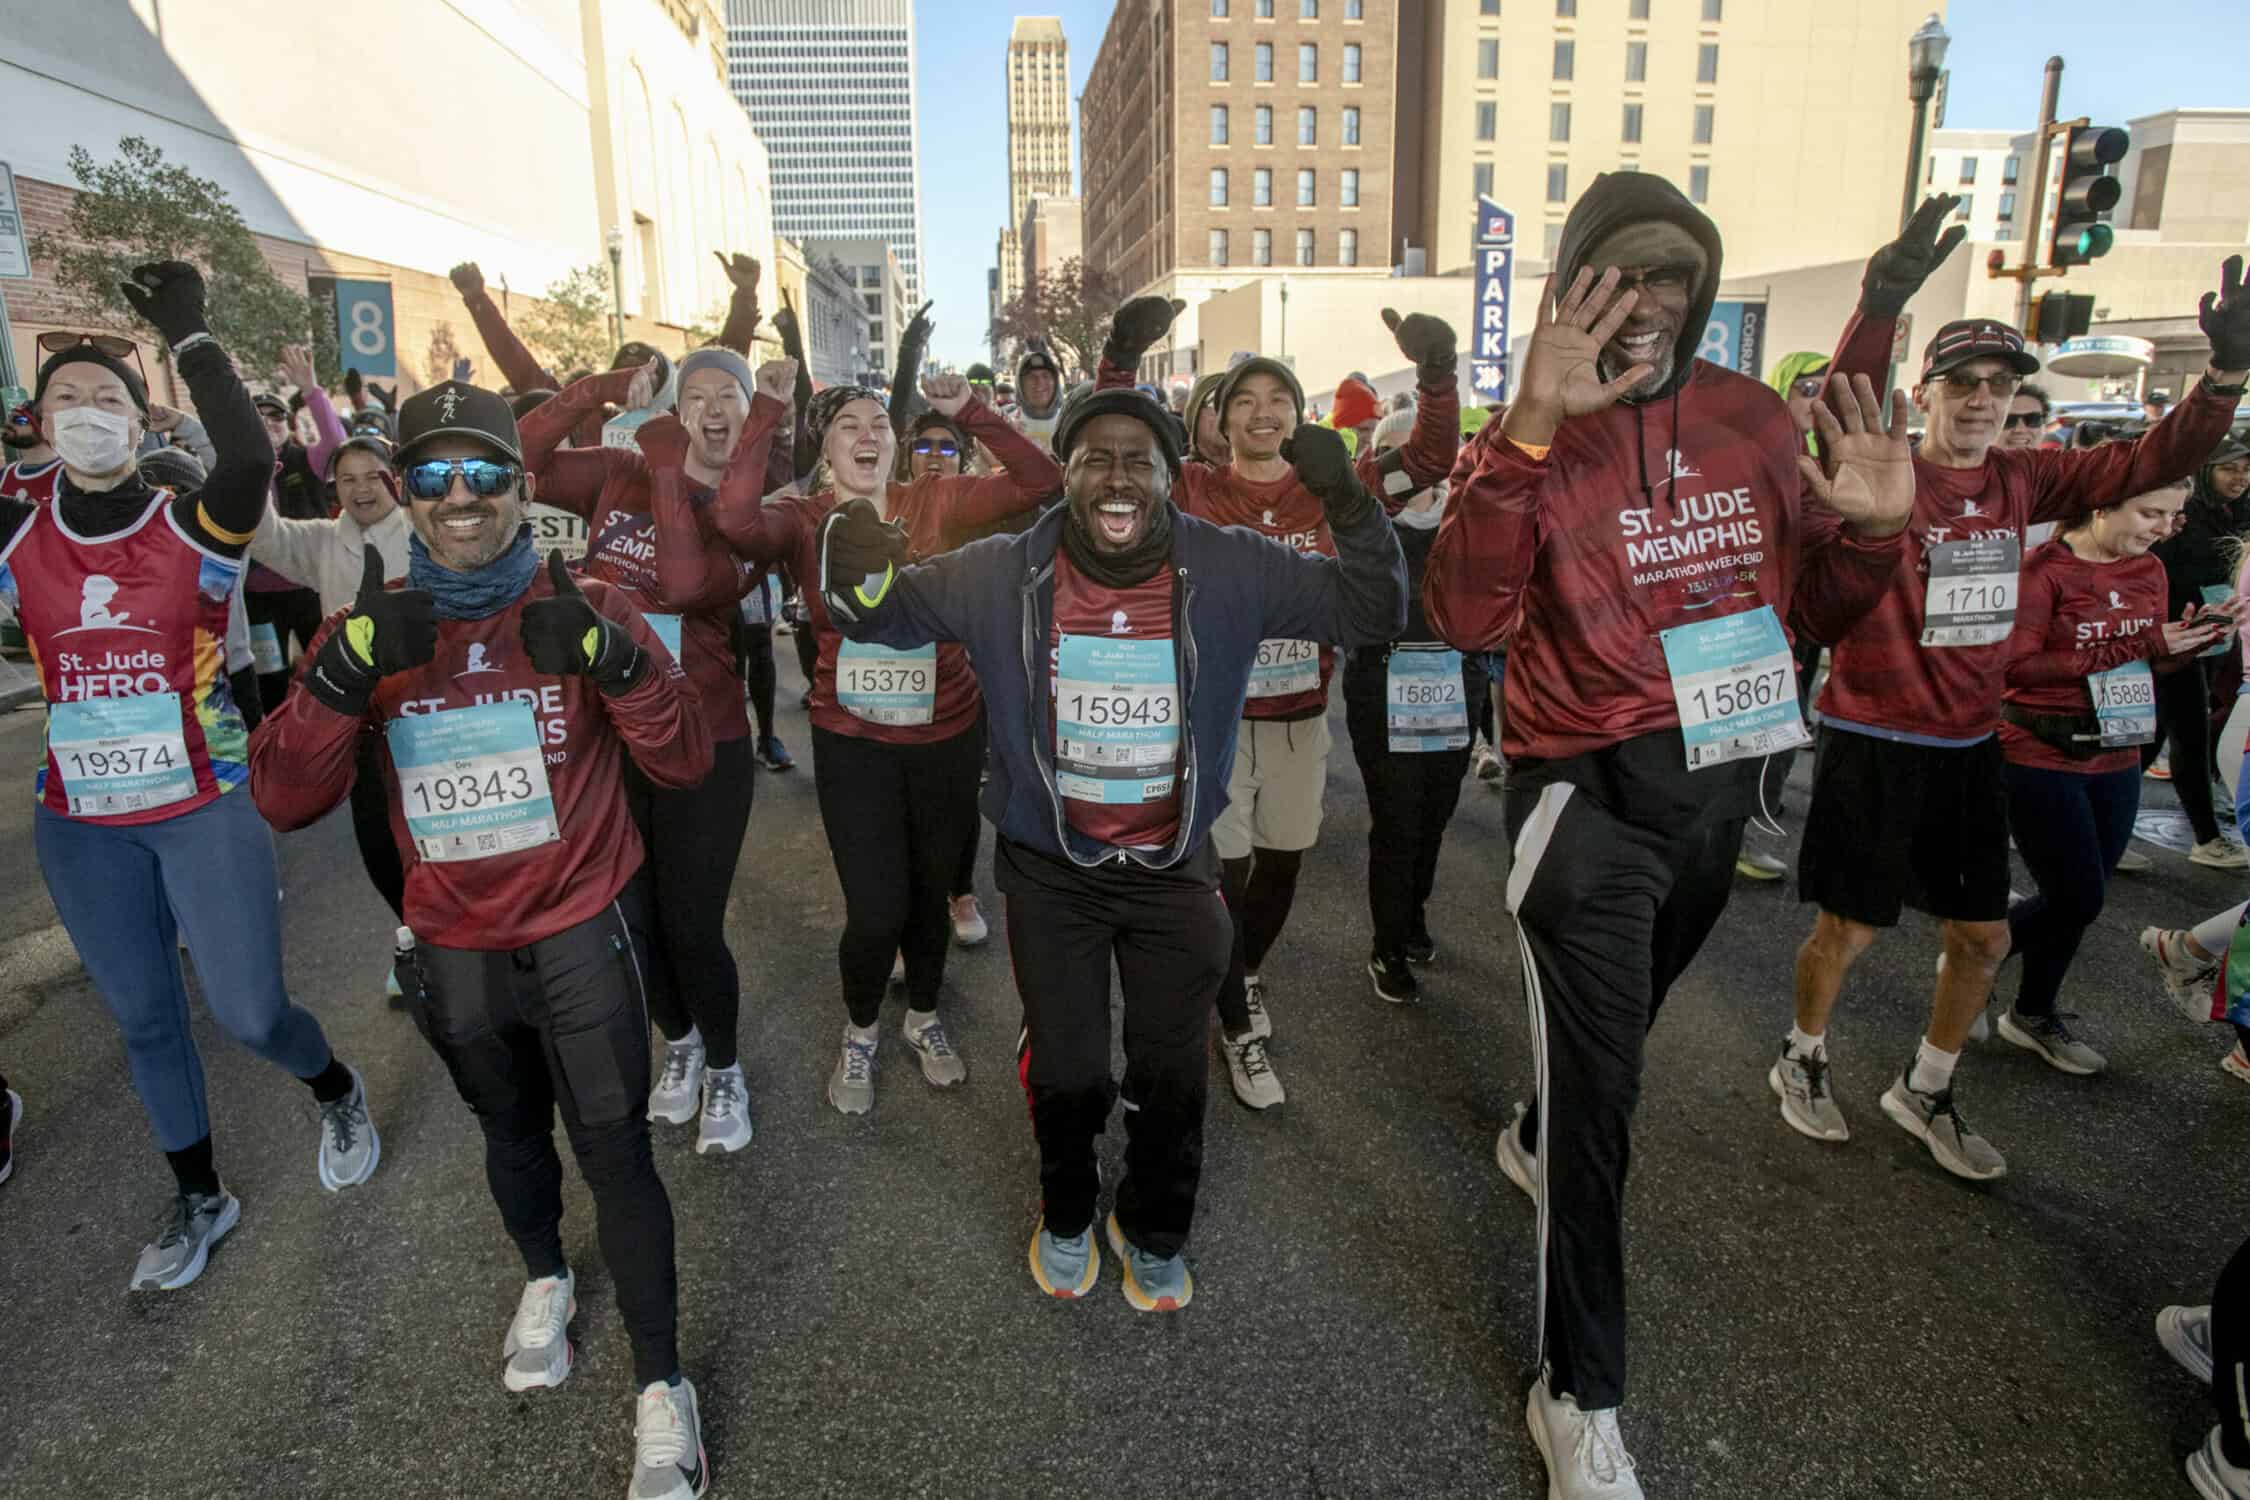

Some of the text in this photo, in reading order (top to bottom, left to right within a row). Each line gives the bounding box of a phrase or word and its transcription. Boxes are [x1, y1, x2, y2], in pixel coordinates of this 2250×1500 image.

[1482, 251, 1505, 356] PARK
[350, 300, 386, 356] 8
[1618, 488, 1756, 537] ST. JUDE
[1626, 519, 1763, 569] MEMPHIS
[1633, 551, 1764, 586] MARATHON WEEKEND
[1946, 585, 2006, 611] 1710
[59, 650, 166, 672] St. Jude
[61, 672, 167, 702] HERO
[847, 669, 926, 692] 15379
[1395, 684, 1456, 704] 15802
[1693, 669, 1786, 720] 15867
[1071, 695, 1171, 725] 15943
[71, 744, 175, 777] 19374
[413, 767, 533, 813] 19343
